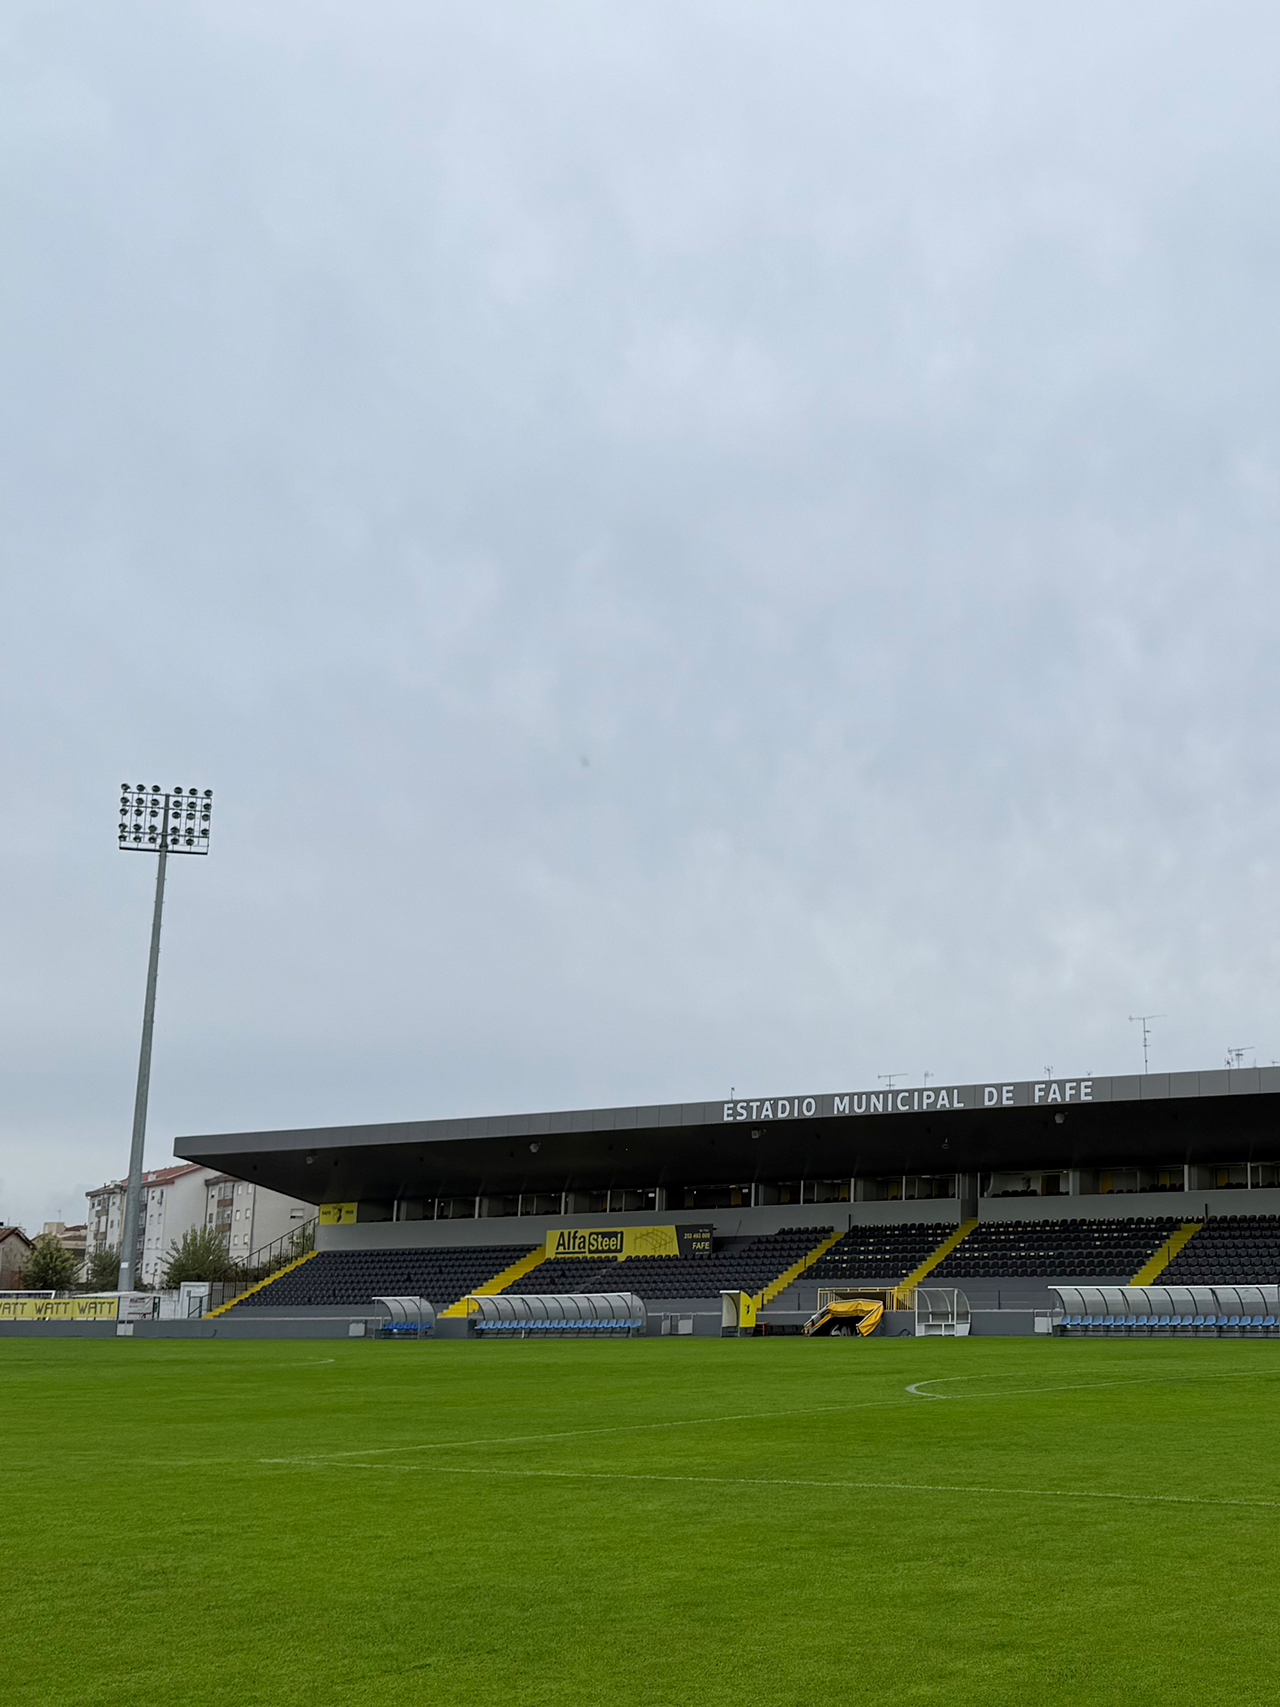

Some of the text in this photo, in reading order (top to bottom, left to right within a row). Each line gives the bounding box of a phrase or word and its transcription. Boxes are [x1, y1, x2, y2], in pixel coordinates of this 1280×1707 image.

[723, 1081, 1093, 1121] ESTÁDIO MUNICIPAL DE FAFE
[692, 1241, 710, 1250] FAFE
[0, 1301, 115, 1315] ATT WATT WATT
